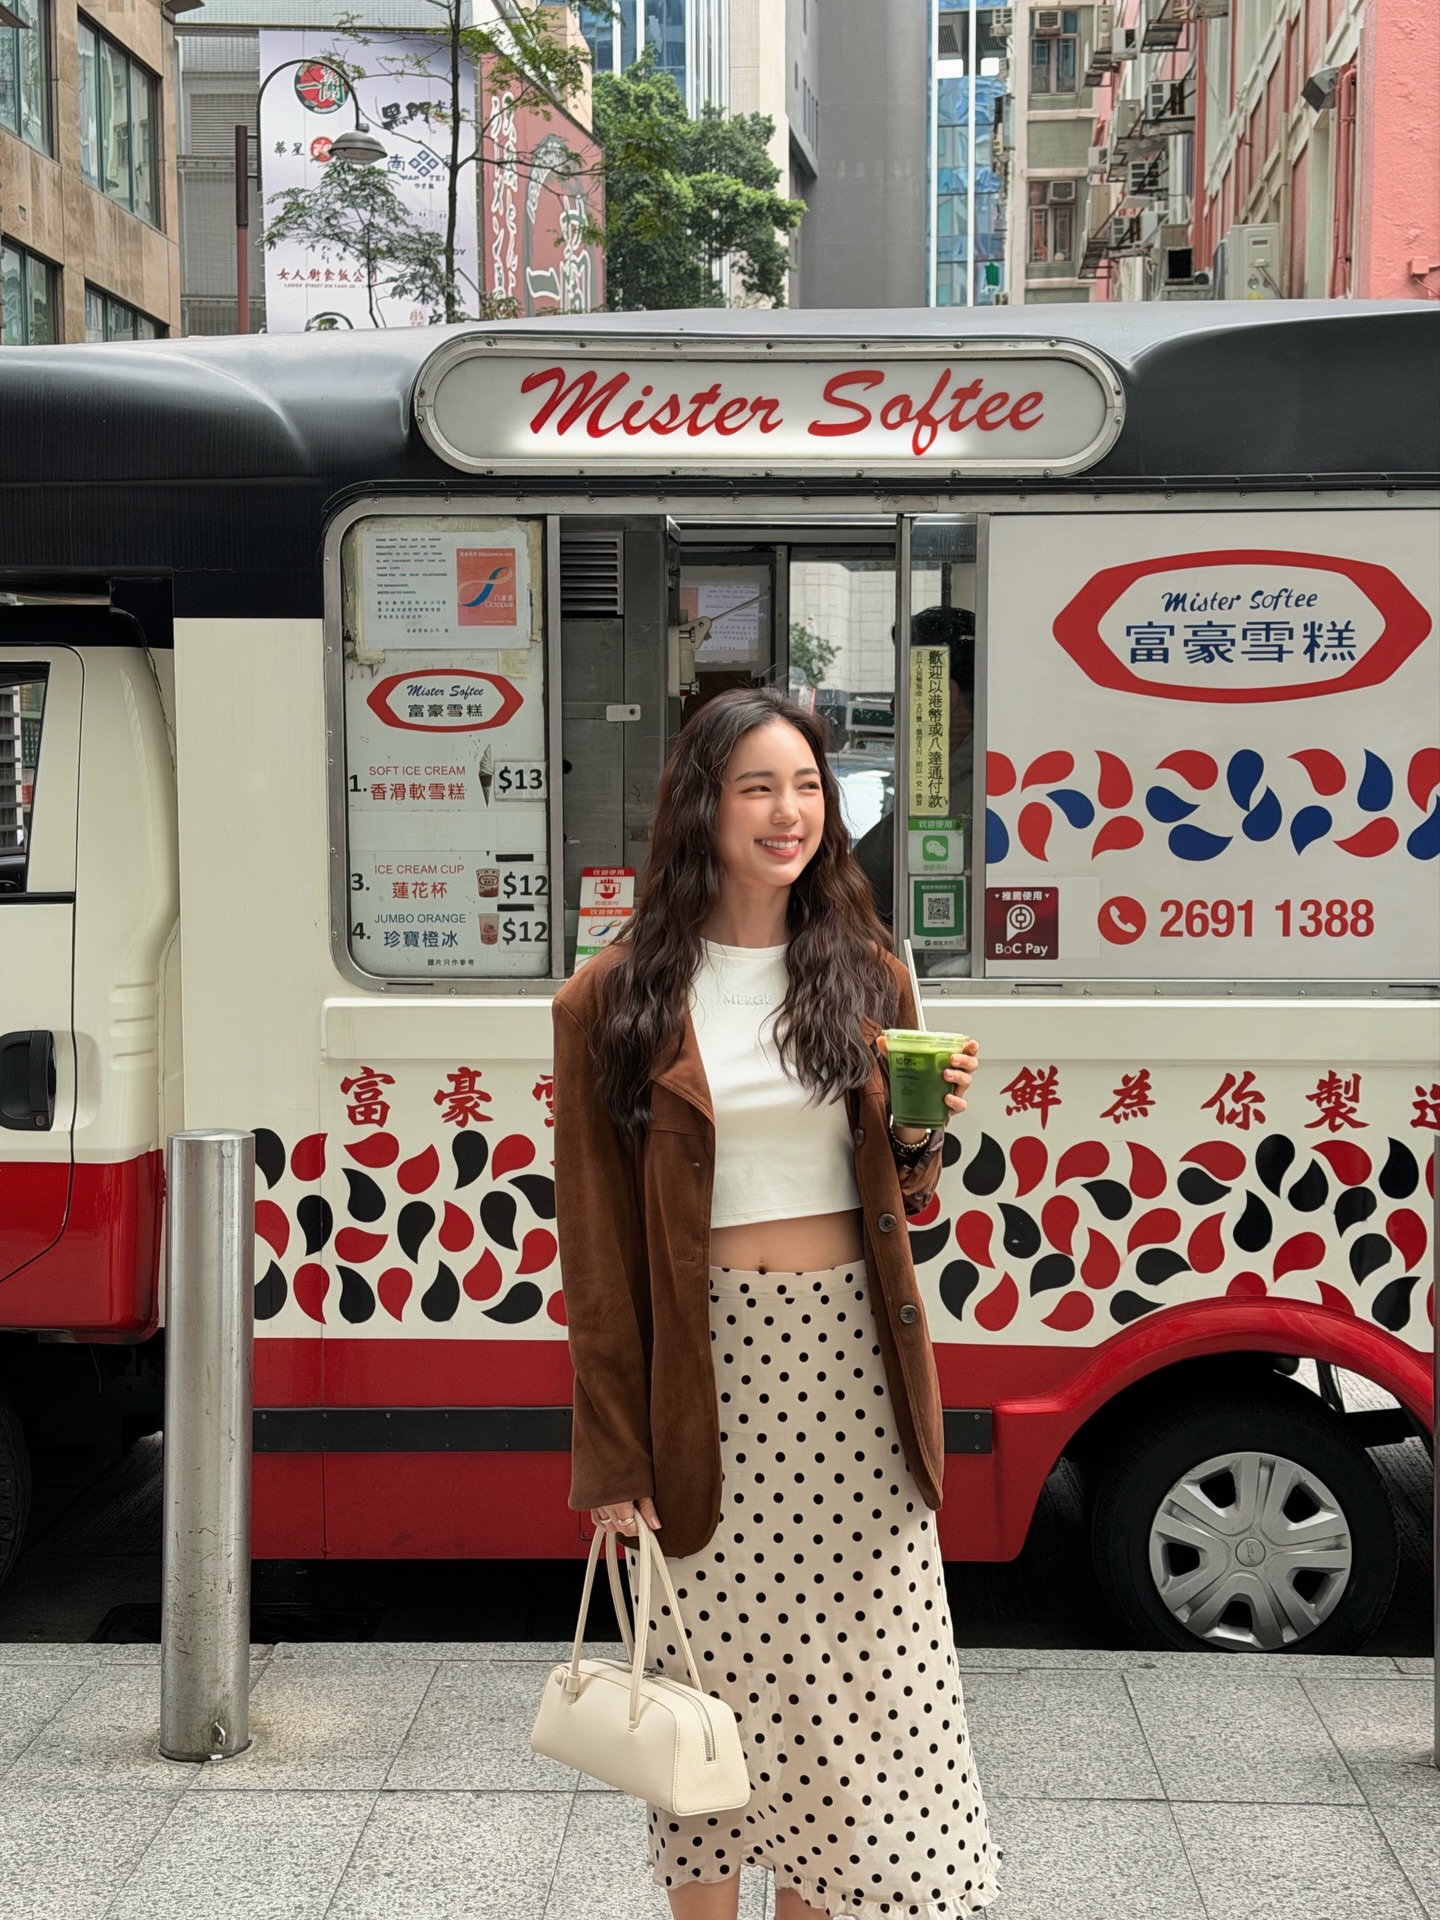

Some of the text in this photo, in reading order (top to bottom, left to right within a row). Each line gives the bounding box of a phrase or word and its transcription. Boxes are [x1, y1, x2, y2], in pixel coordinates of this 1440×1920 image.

[520, 367, 1044, 456] Mister Softee
[484, 600, 514, 609] Octopus
[1161, 588, 1318, 613] Mister Softee
[1126, 620, 1357, 664] 富豪雪糕
[407, 685, 484, 700] Mister Softee
[408, 704, 483, 718] 富豪雪糕
[928, 650, 943, 808] 歡迎以港幣或八達通付款
[369, 766, 466, 776] SOFT ICE CREAM
[498, 766, 543, 793] $13
[349, 774, 367, 792] 1.
[370, 782, 465, 800] 香滑軟雪糕
[374, 865, 465, 874] ICE CREAM CUP
[351, 873, 370, 891] 3.
[392, 881, 448, 899] 蓮花杯
[503, 871, 549, 899] $12
[1002, 891, 1043, 901] 推薦使用
[374, 914, 466, 924] JUMBO ORANGE
[1160, 899, 1375, 938] 2691 1388
[352, 922, 371, 940] 4.
[383, 930, 459, 948] 珍寶橙冰
[502, 918, 549, 945] $12
[995, 943, 1049, 957] BoC Pay
